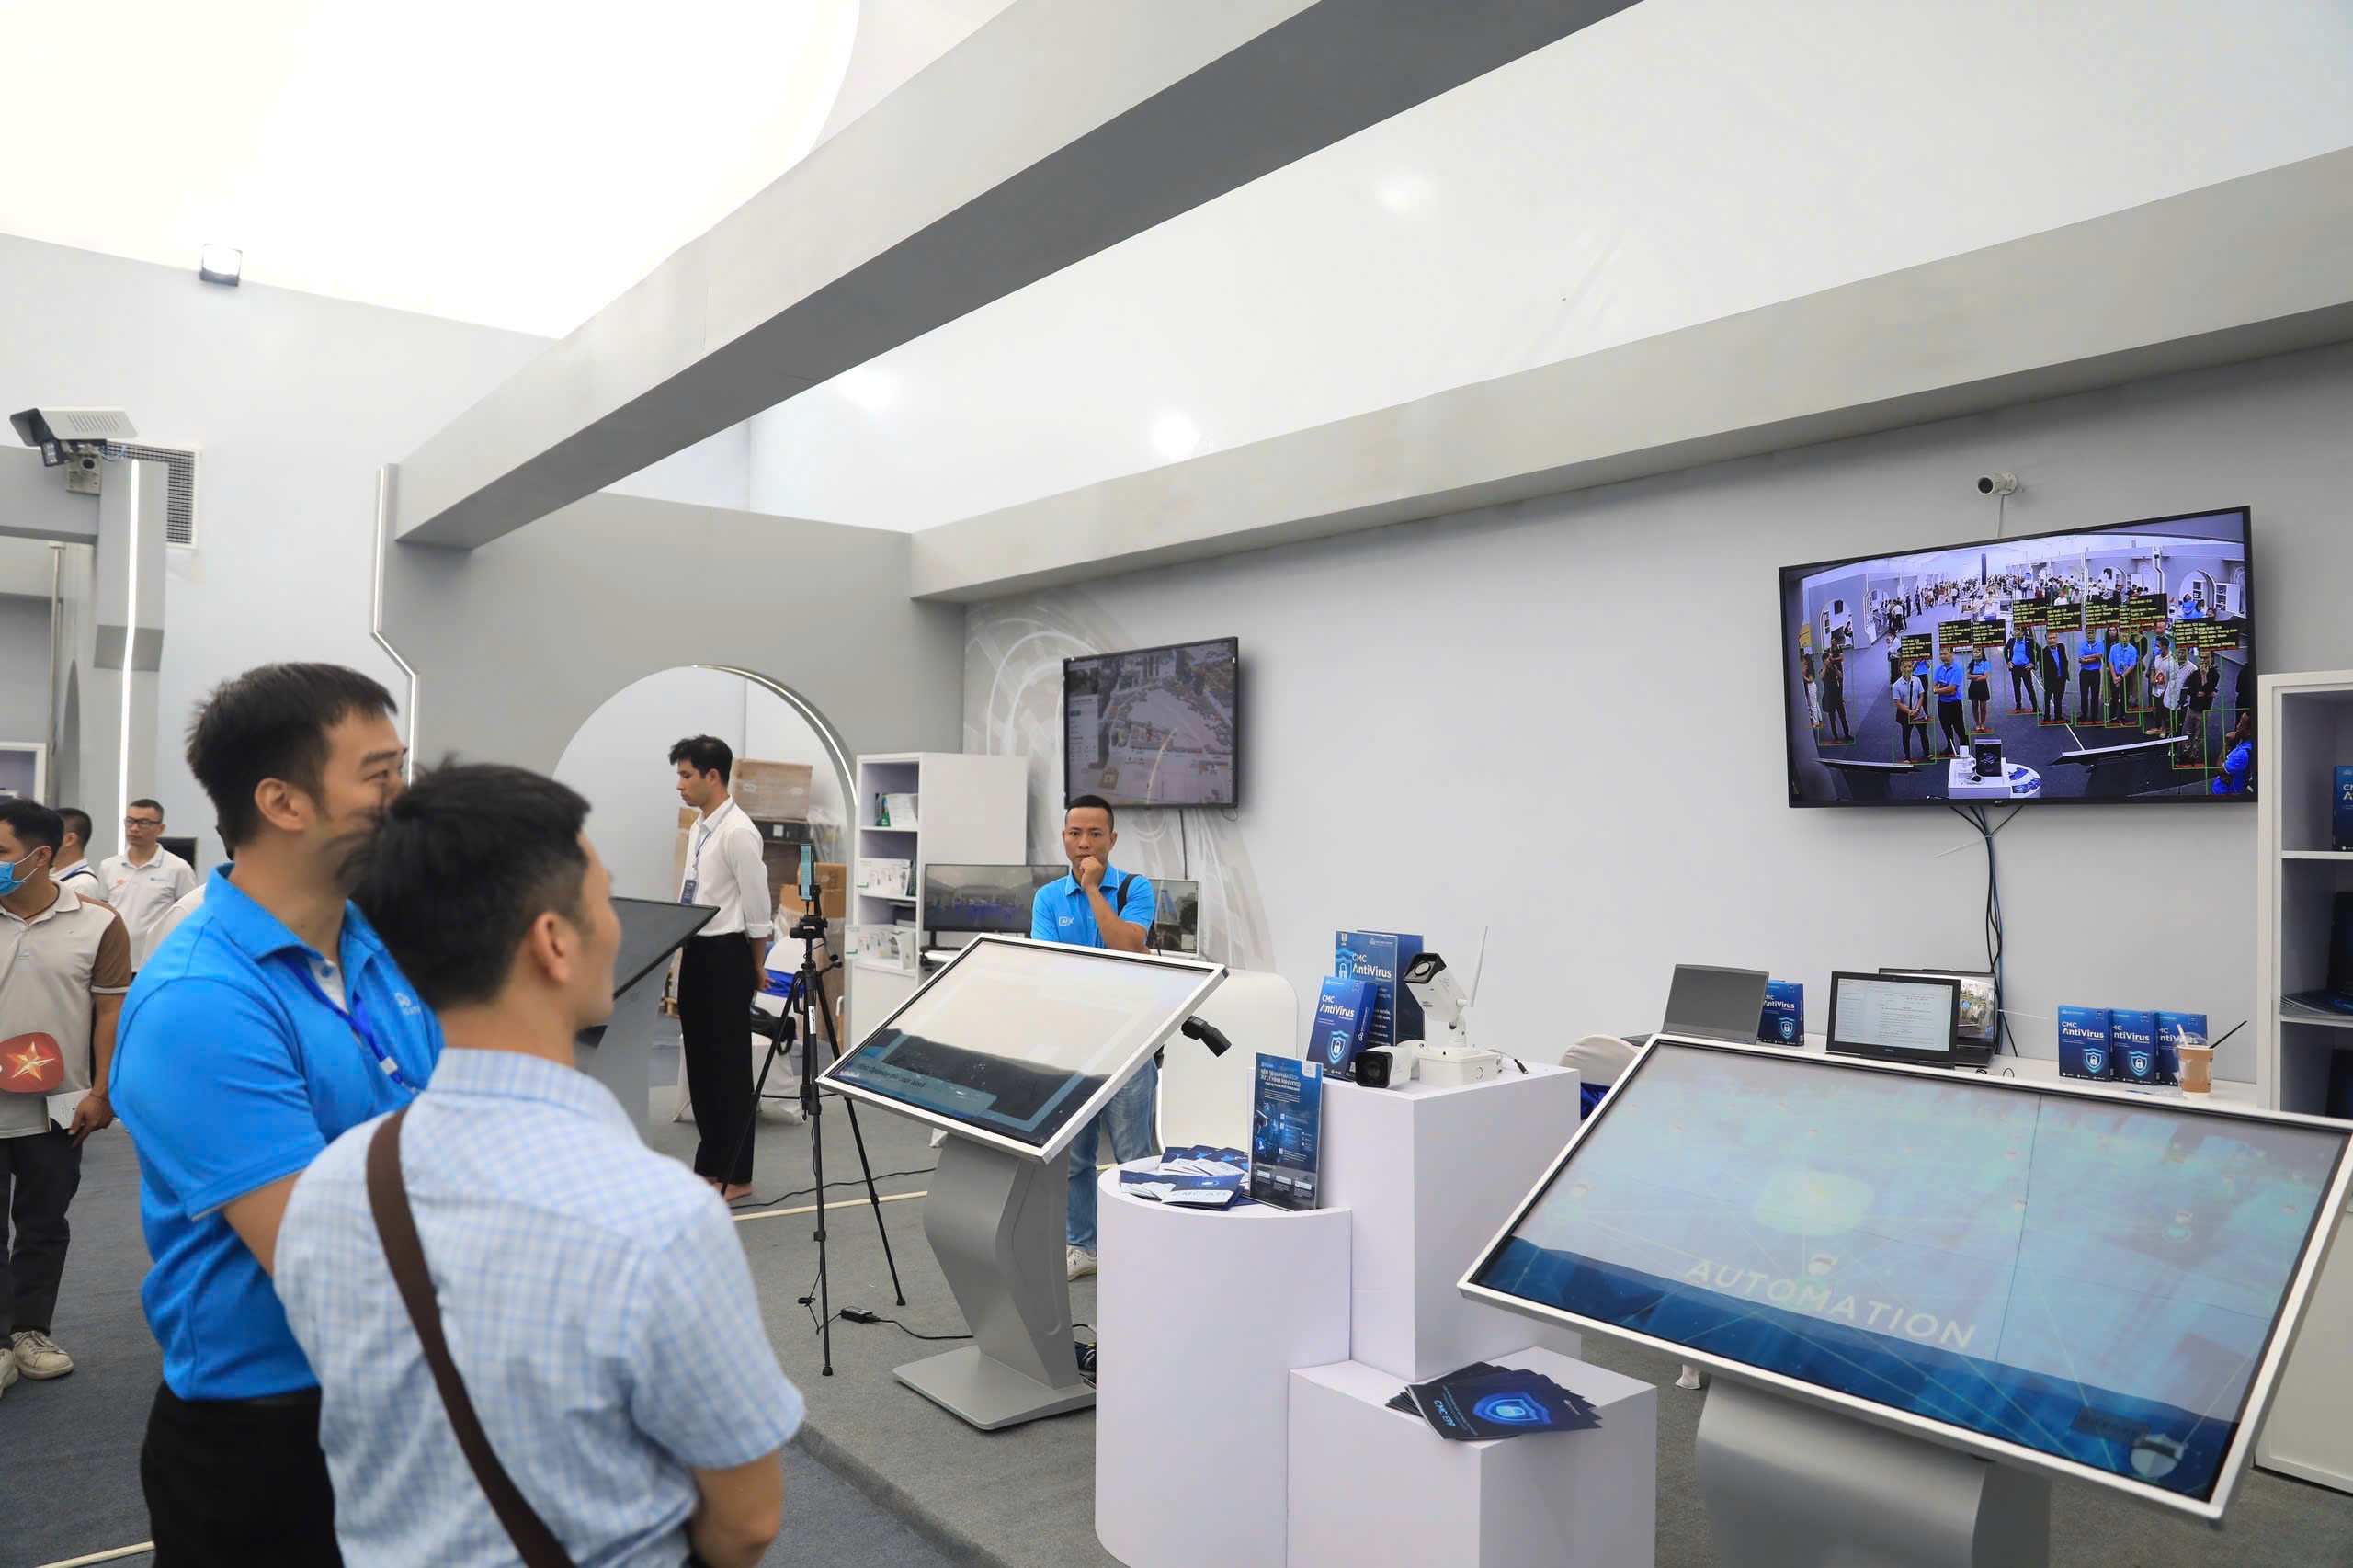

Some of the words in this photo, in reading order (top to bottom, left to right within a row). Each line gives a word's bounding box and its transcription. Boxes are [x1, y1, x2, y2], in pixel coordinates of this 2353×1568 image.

[1352, 953, 1367, 963] CMC
[1352, 963, 1392, 978] AntiVirus
[1320, 1004, 1354, 1017] AntiVirus
[2062, 1028, 2105, 1039] AntiVirus
[2114, 1031, 2150, 1042] ntiVirus
[1684, 1259, 1977, 1348] AUTOMATION
[1434, 1400, 1448, 1415] CMC
